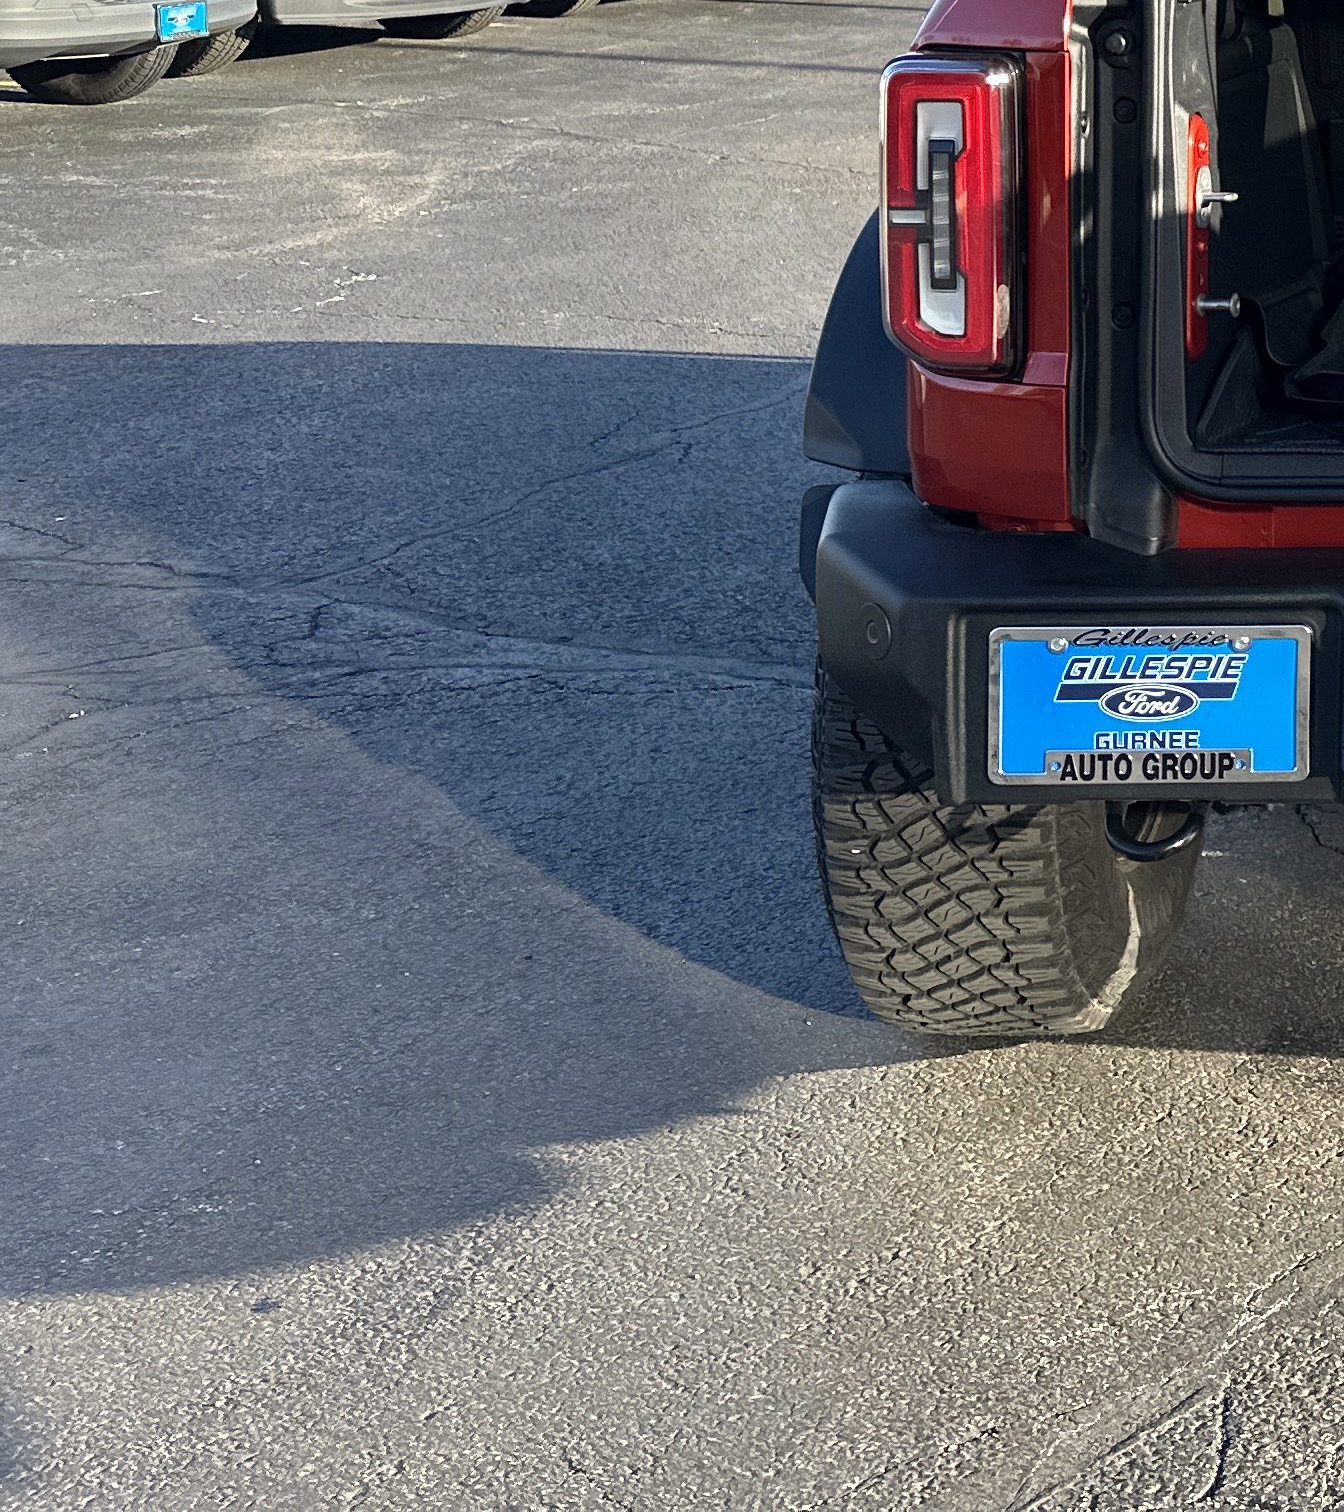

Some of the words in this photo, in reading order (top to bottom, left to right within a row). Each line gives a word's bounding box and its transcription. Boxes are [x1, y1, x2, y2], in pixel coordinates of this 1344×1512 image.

[1073, 628, 1228, 651] Gillespie
[1063, 654, 1248, 680] GILLESPIE
[1118, 689, 1181, 714] Ford
[1095, 731, 1199, 749] GURNEE
[1060, 753, 1132, 781] AUTO
[1142, 753, 1235, 780] GROUP
